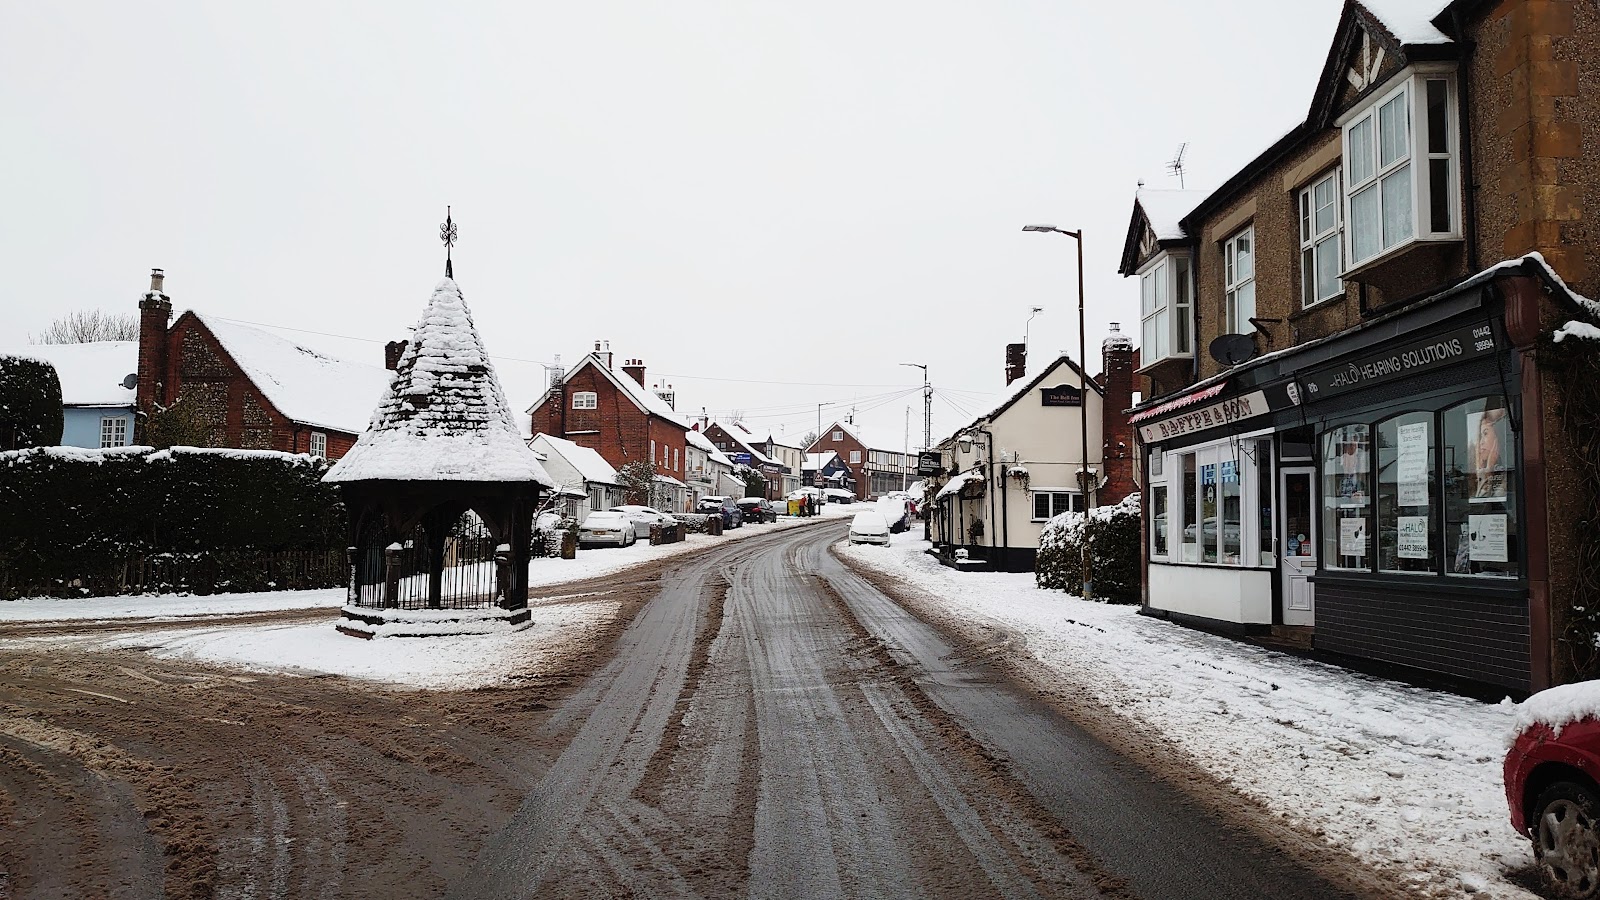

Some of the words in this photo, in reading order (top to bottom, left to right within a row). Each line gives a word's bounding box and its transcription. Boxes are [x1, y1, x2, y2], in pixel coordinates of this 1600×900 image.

[1472, 325, 1492, 339] 01442
[1474, 338, 1495, 352] 38994
[1334, 371, 1359, 388] HALO
[1360, 356, 1401, 380] HEARING
[1402, 338, 1463, 369] SOLUTIONS
[1213, 407, 1225, 424] &
[1222, 397, 1253, 420] SON
[1405, 522, 1424, 533] HALO
